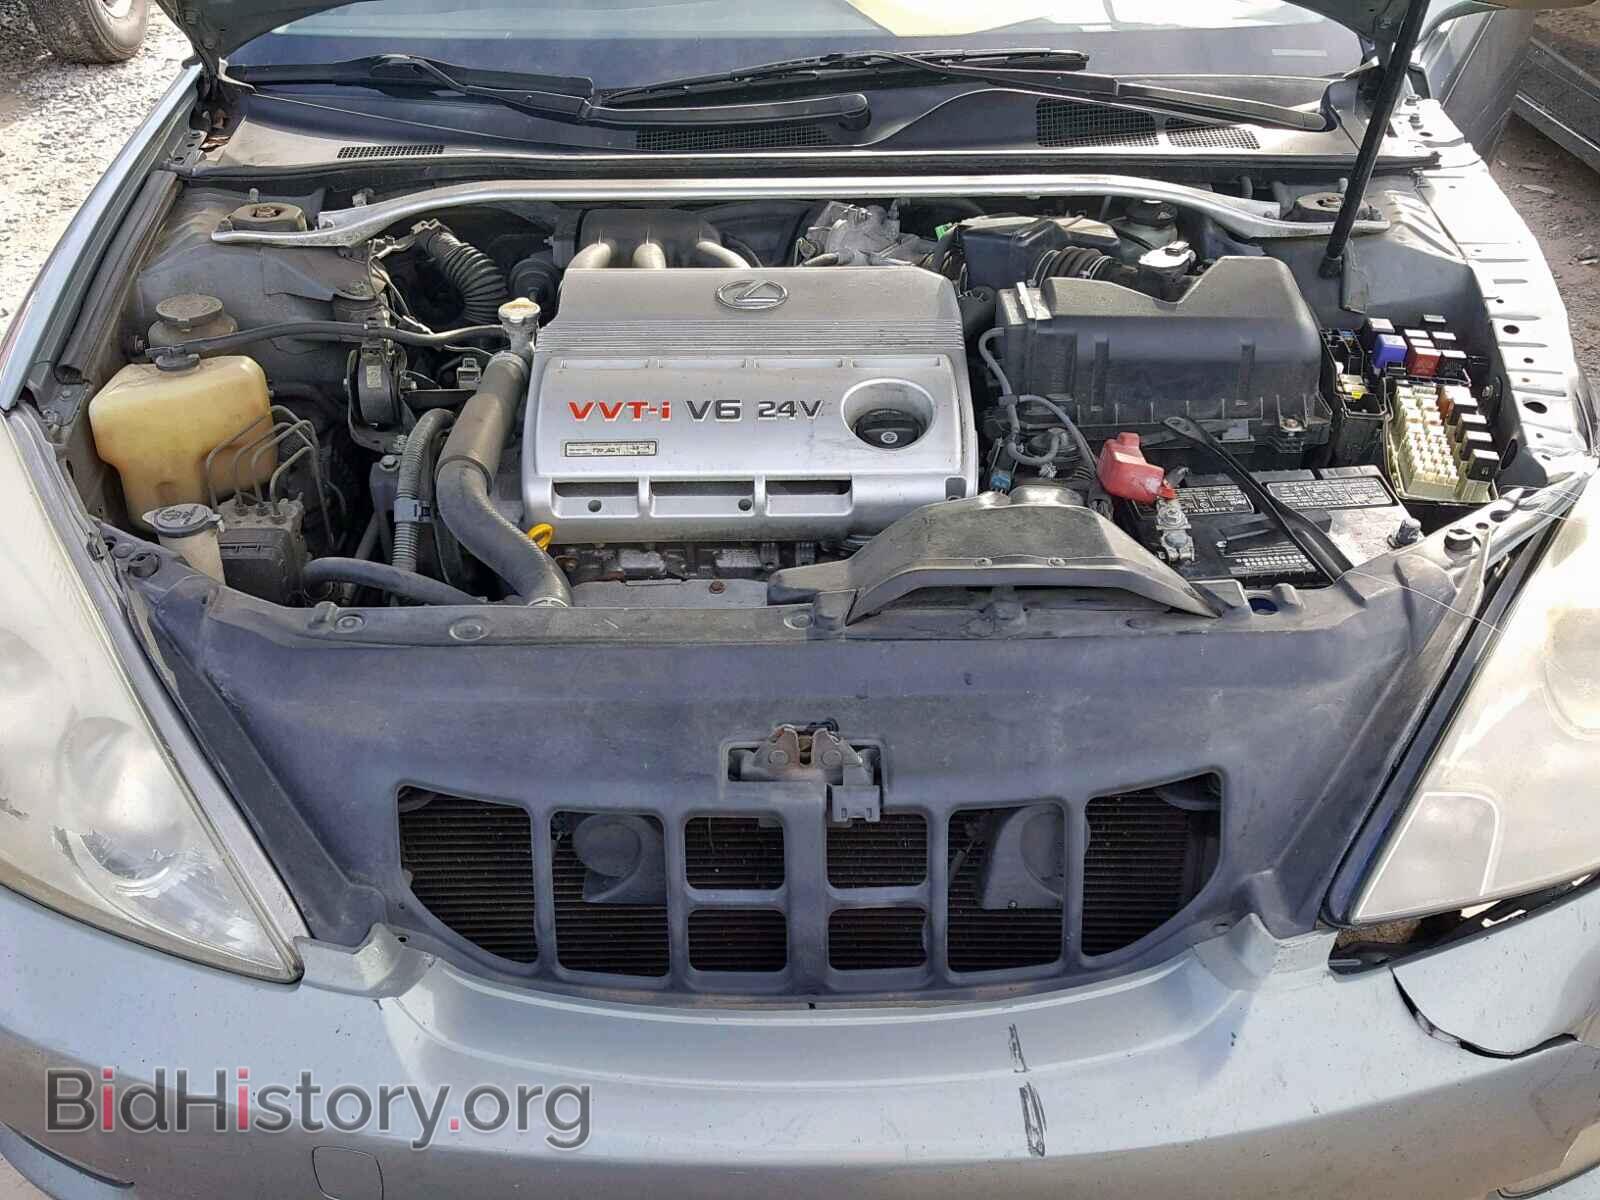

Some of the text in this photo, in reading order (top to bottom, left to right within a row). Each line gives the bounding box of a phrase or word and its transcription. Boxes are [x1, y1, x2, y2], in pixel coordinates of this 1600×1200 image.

[568, 400, 824, 422] VVT-i V6 24V
